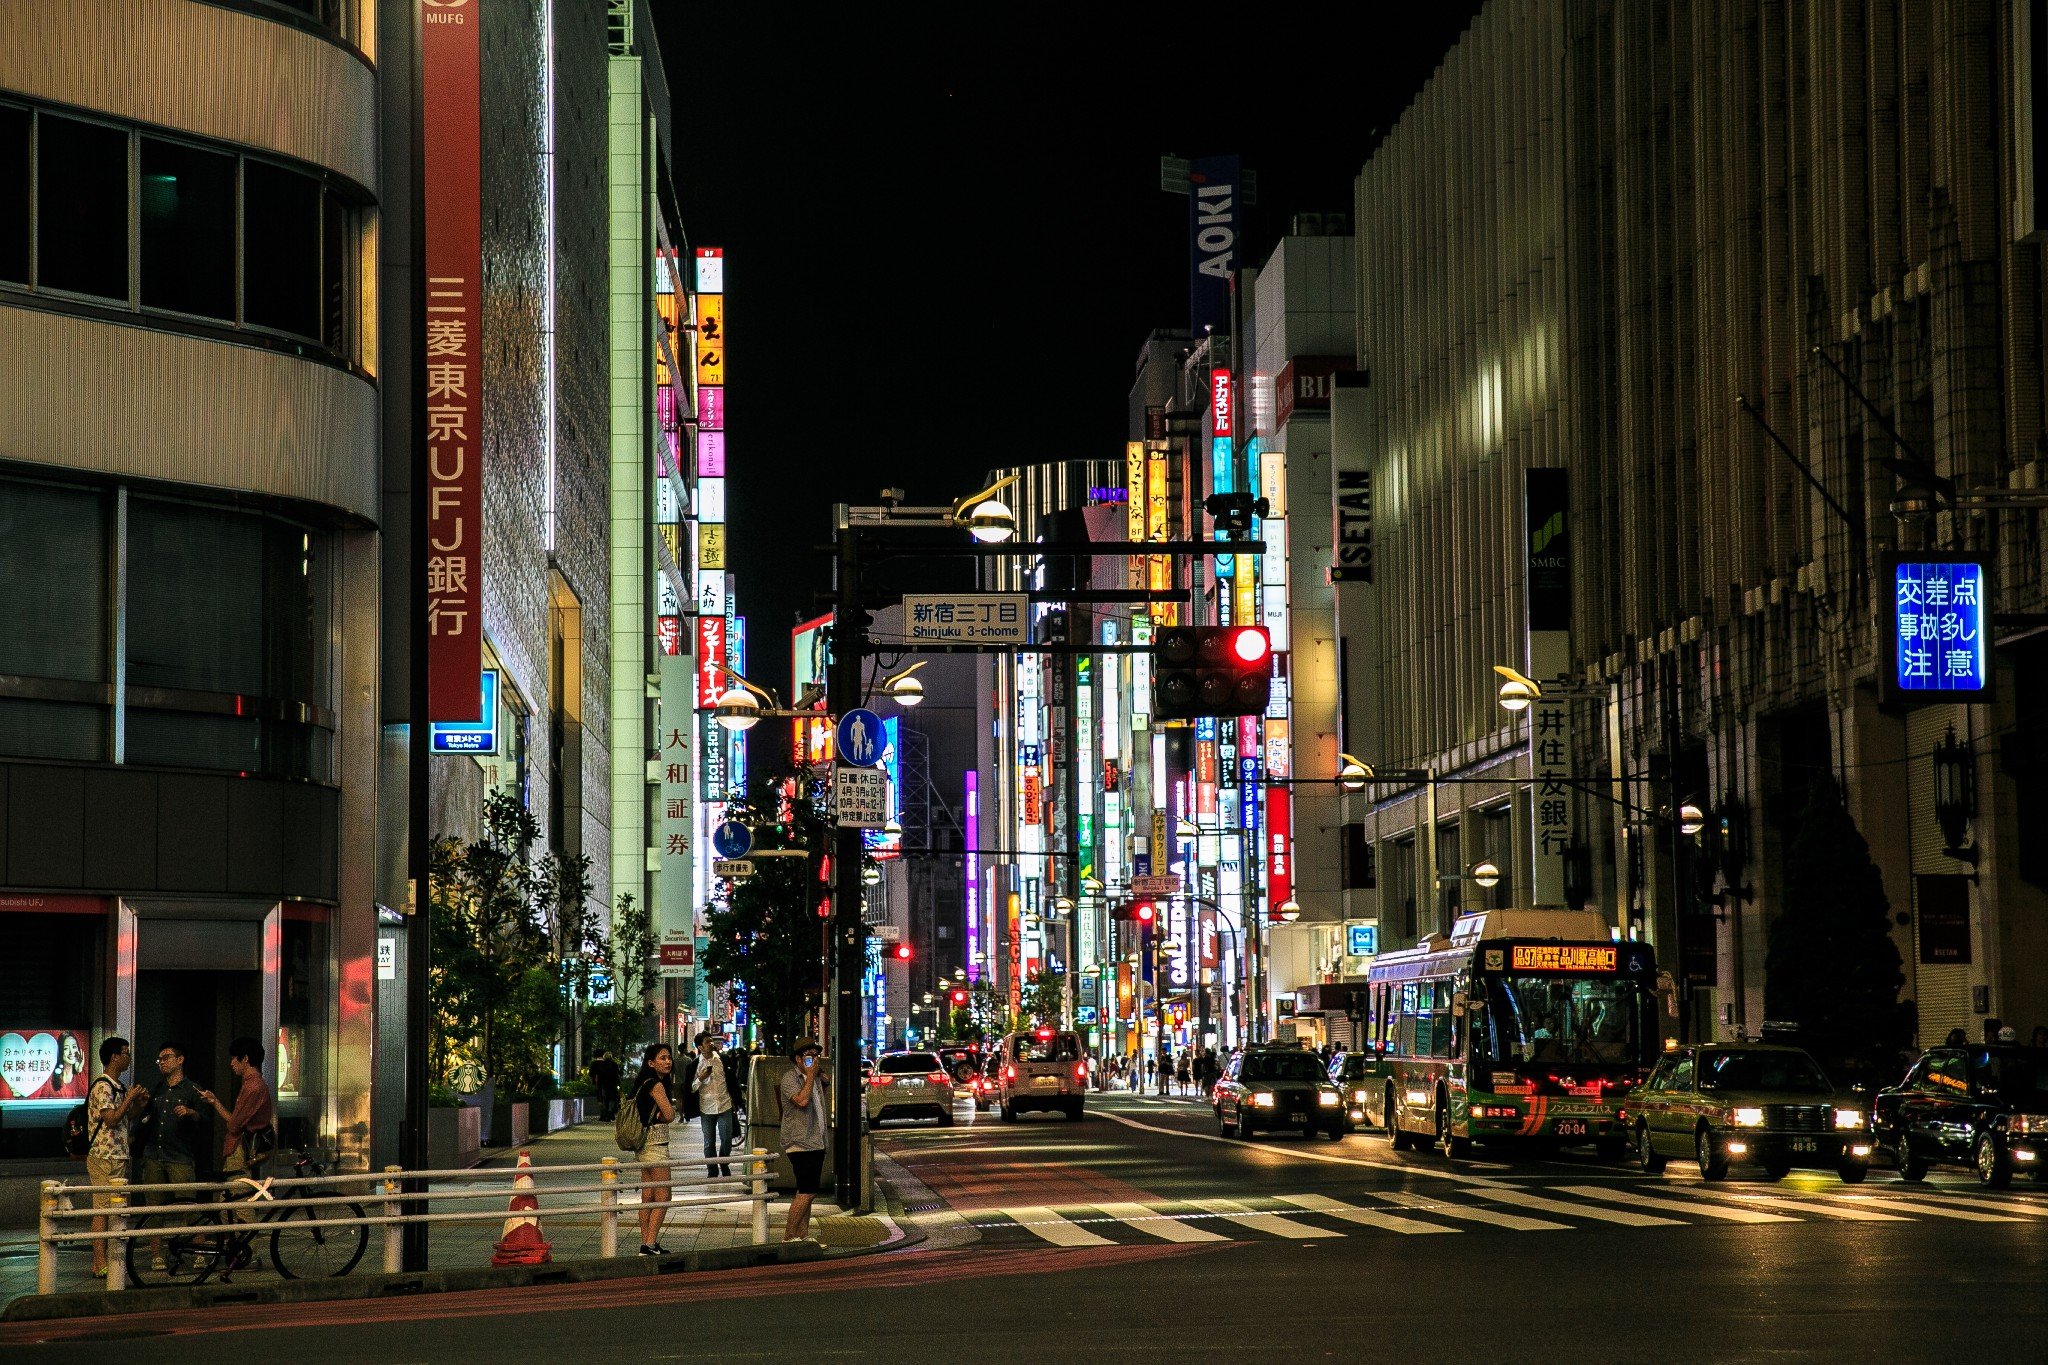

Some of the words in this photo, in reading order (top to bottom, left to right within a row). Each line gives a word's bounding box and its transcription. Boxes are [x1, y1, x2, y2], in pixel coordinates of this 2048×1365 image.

[426, 13, 464, 25] MUFG
[1197, 184, 1234, 279] AOKI
[1215, 376, 1228, 431] アカネビル
[427, 278, 468, 636] 三菱東京UFJ銀行
[1530, 557, 1566, 568] SMBC
[1897, 577, 1977, 606] 交差点
[726, 596, 734, 639] MEGANE
[913, 602, 1018, 623] 新宿三丁目
[913, 626, 961, 639] Shinjuku
[967, 626, 1019, 637] 3-chome
[1899, 612, 1977, 642] 事故多し
[726, 642, 734, 662] TOP
[1903, 648, 1974, 678] 注意
[445, 735, 482, 743] 東京メトロ
[1538, 680, 1568, 856] 三井住友銀行
[665, 728, 689, 856] 大和証券
[716, 863, 749, 873] 歩行者優先
[29, 898, 44, 907] UFJ
[1515, 948, 1536, 966] 品97
[1560, 948, 1615, 966] 品川駅高輪口
[717, 987, 725, 1020] ROLEX
[4, 1047, 51, 1057] 分かりやすい
[3, 1060, 51, 1072] 保険相談
[1550, 1104, 1613, 1114] ノンステップバス
[1558, 1124, 1586, 1135] 20-04
[1792, 1142, 1817, 1152] 48-85
